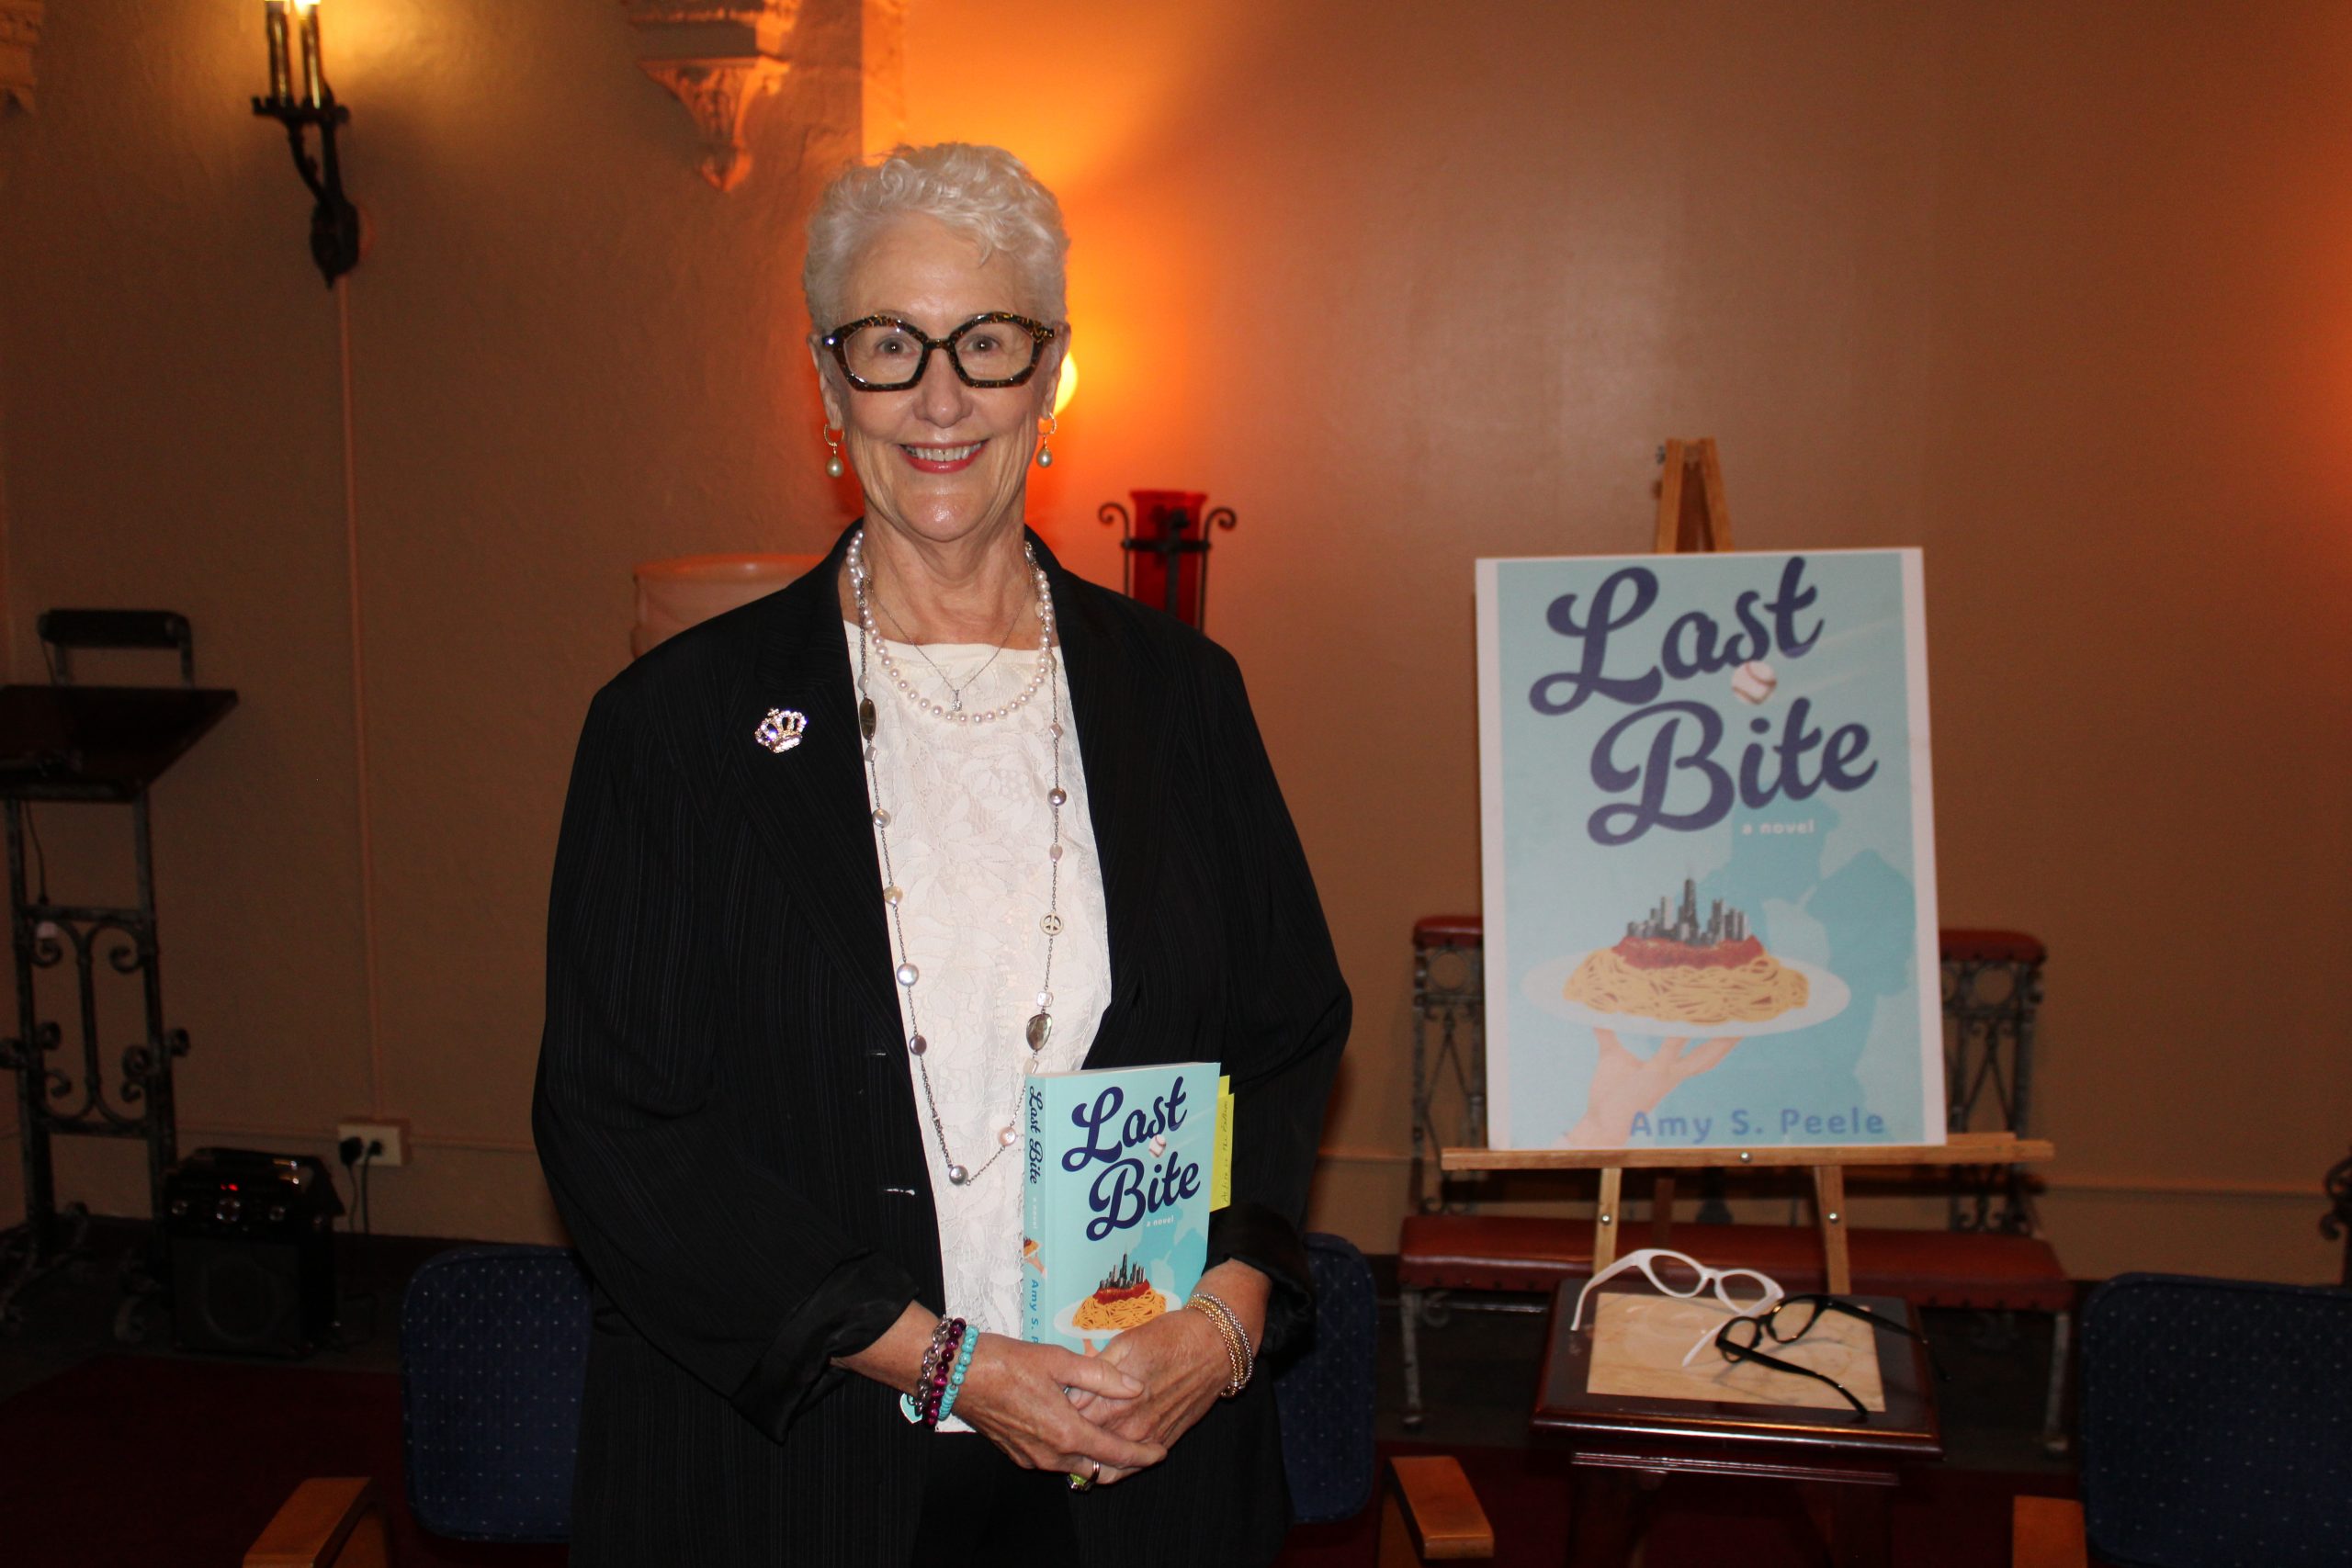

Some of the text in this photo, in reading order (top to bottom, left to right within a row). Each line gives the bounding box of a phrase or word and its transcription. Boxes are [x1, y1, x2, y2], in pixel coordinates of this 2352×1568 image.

[1529, 556, 1825, 716] Last
[1587, 696, 1878, 847] Bite
[1742, 818, 1815, 835] a novel
[1029, 1086, 1044, 1184] Last Bite
[1061, 1076, 1188, 1172] Last
[1629, 1105, 1884, 1145] Amy S. Peele
[1086, 1151, 1201, 1241] Bite
[1153, 1214, 1174, 1226] novel
[1029, 1279, 1039, 1312] Amy
[1031, 1317, 1039, 1330] S.
